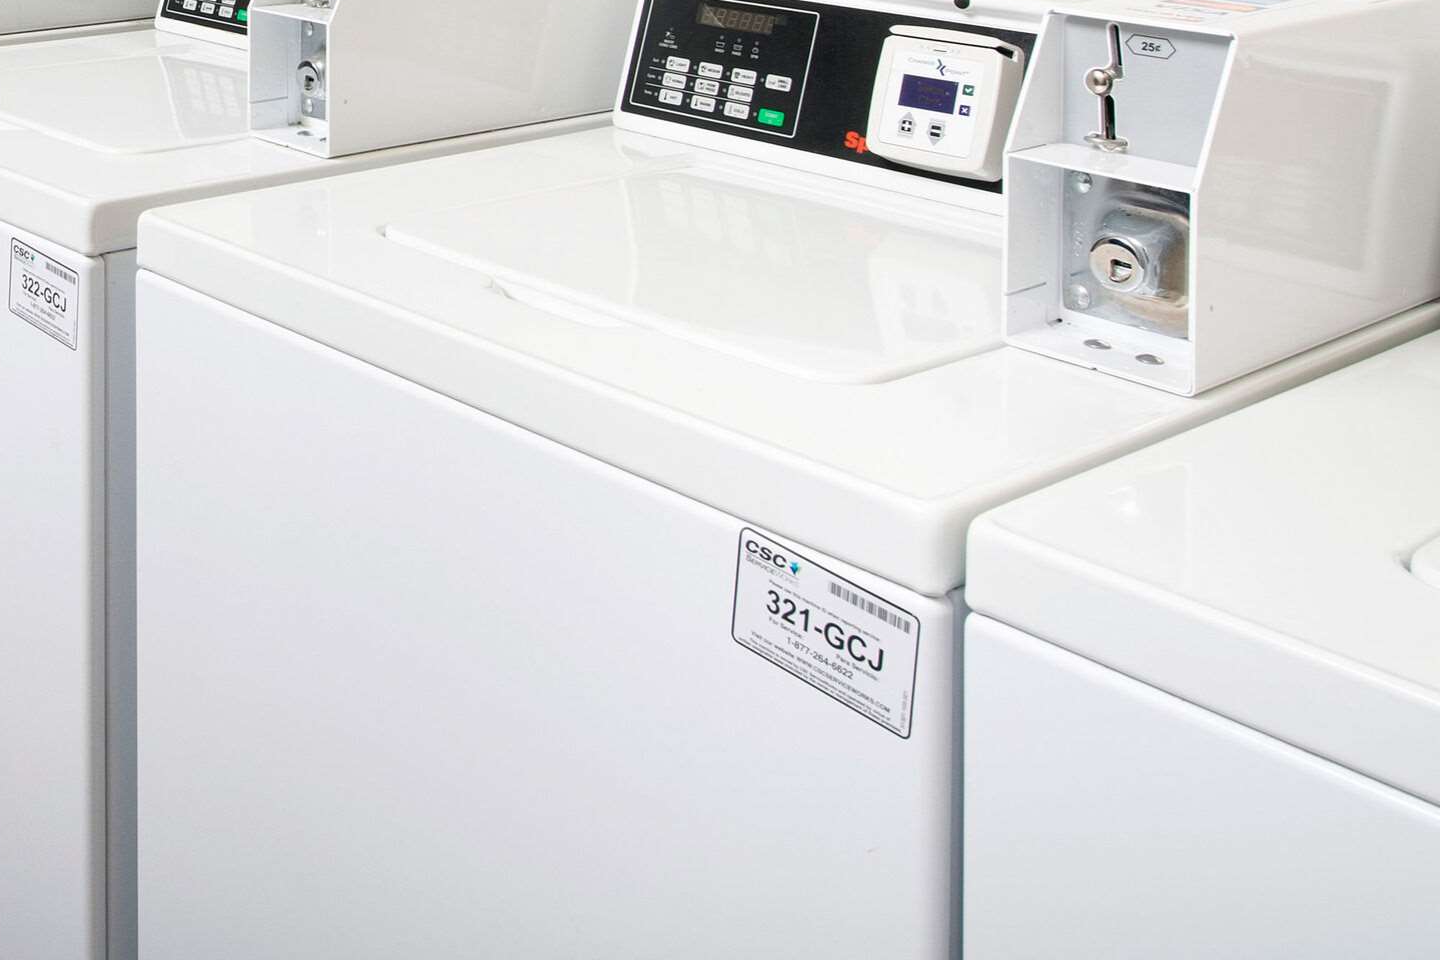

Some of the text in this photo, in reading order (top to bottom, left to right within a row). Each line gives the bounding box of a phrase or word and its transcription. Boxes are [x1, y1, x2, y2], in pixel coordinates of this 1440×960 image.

[14, 244, 30, 260] CSC
[22, 274, 67, 312] 322-GCJ
[745, 540, 788, 569] CSC
[766, 590, 884, 672] 321-GCJ
[787, 634, 853, 681] 1-877-264-6622
